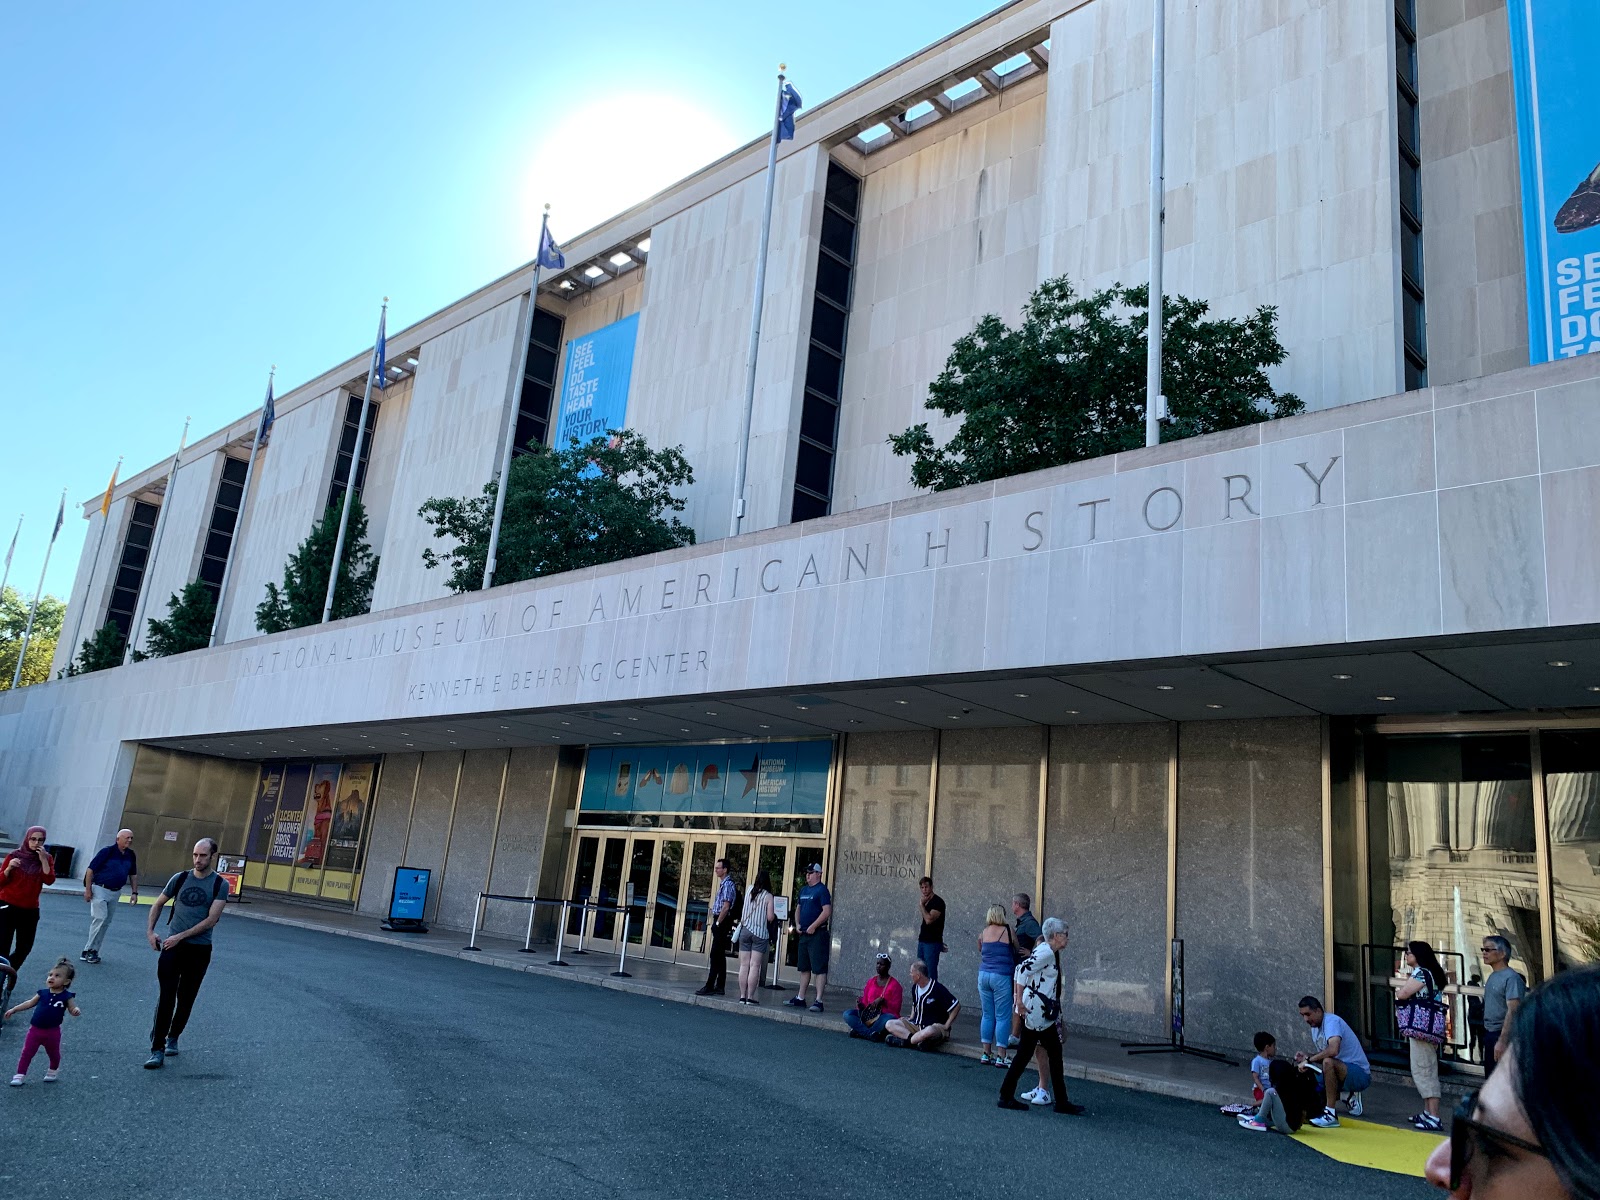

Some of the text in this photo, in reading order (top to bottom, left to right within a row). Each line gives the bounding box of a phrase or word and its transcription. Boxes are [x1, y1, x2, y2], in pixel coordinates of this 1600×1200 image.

[574, 340, 594, 360] SEE
[572, 353, 596, 374] FEEL
[570, 369, 584, 387] DO
[568, 378, 600, 401] TASTE
[566, 393, 593, 415] HEAR
[564, 408, 593, 428] YOUR
[562, 417, 609, 443] HISTORY
[242, 455, 1343, 677] NATIONAL MUSEUM OF AMERICAN HISTORY
[408, 676, 485, 701] KENNETH
[511, 662, 603, 691] BEHRING
[615, 650, 709, 680] CENTER
[843, 849, 921, 866] SMITHSONIAN
[845, 863, 916, 879] INSTITUTION
